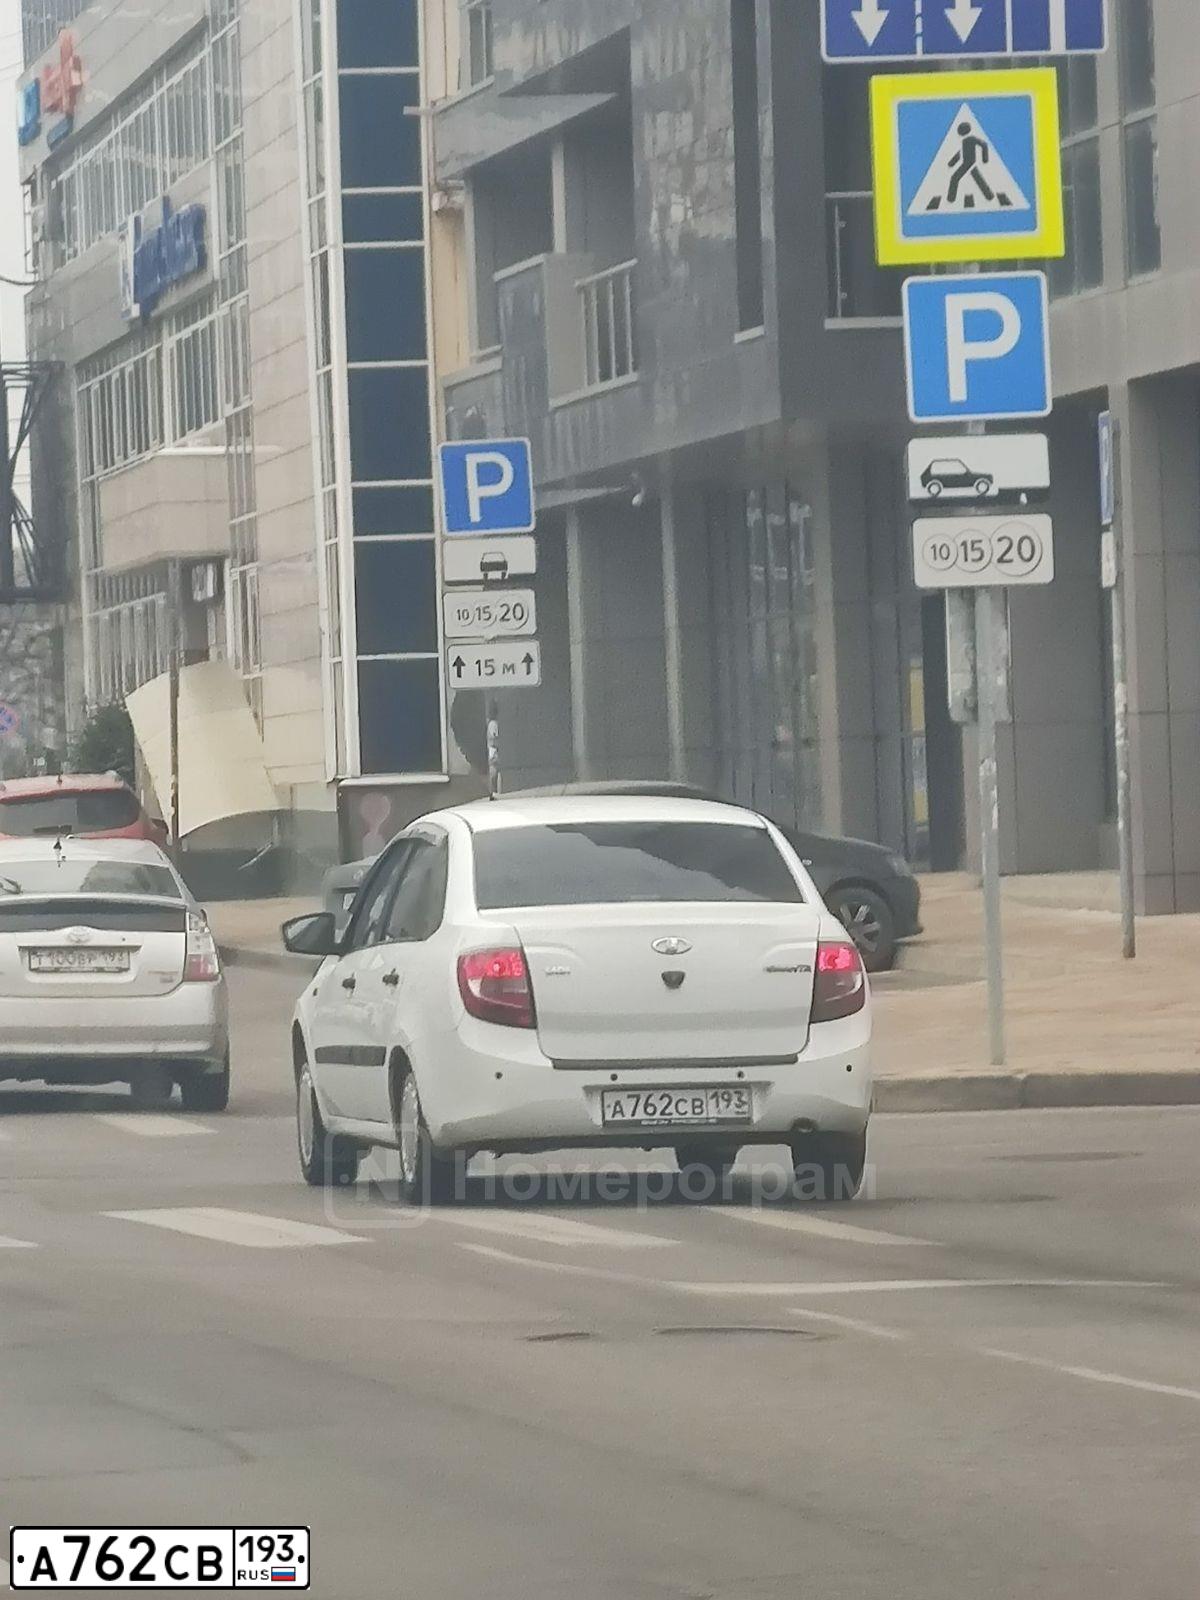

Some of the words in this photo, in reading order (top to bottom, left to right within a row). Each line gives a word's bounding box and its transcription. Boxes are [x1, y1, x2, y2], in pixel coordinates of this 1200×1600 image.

[945, 291, 1021, 402] P
[465, 451, 515, 523] P
[930, 543, 950, 561] 10
[960, 539, 985, 563] 15
[997, 535, 1036, 563] 20
[457, 608, 470, 621] 10
[475, 605, 492, 621] 15
[499, 602, 525, 622] 20
[475, 658, 496, 677] 15
[709, 1091, 744, 1109] 193
